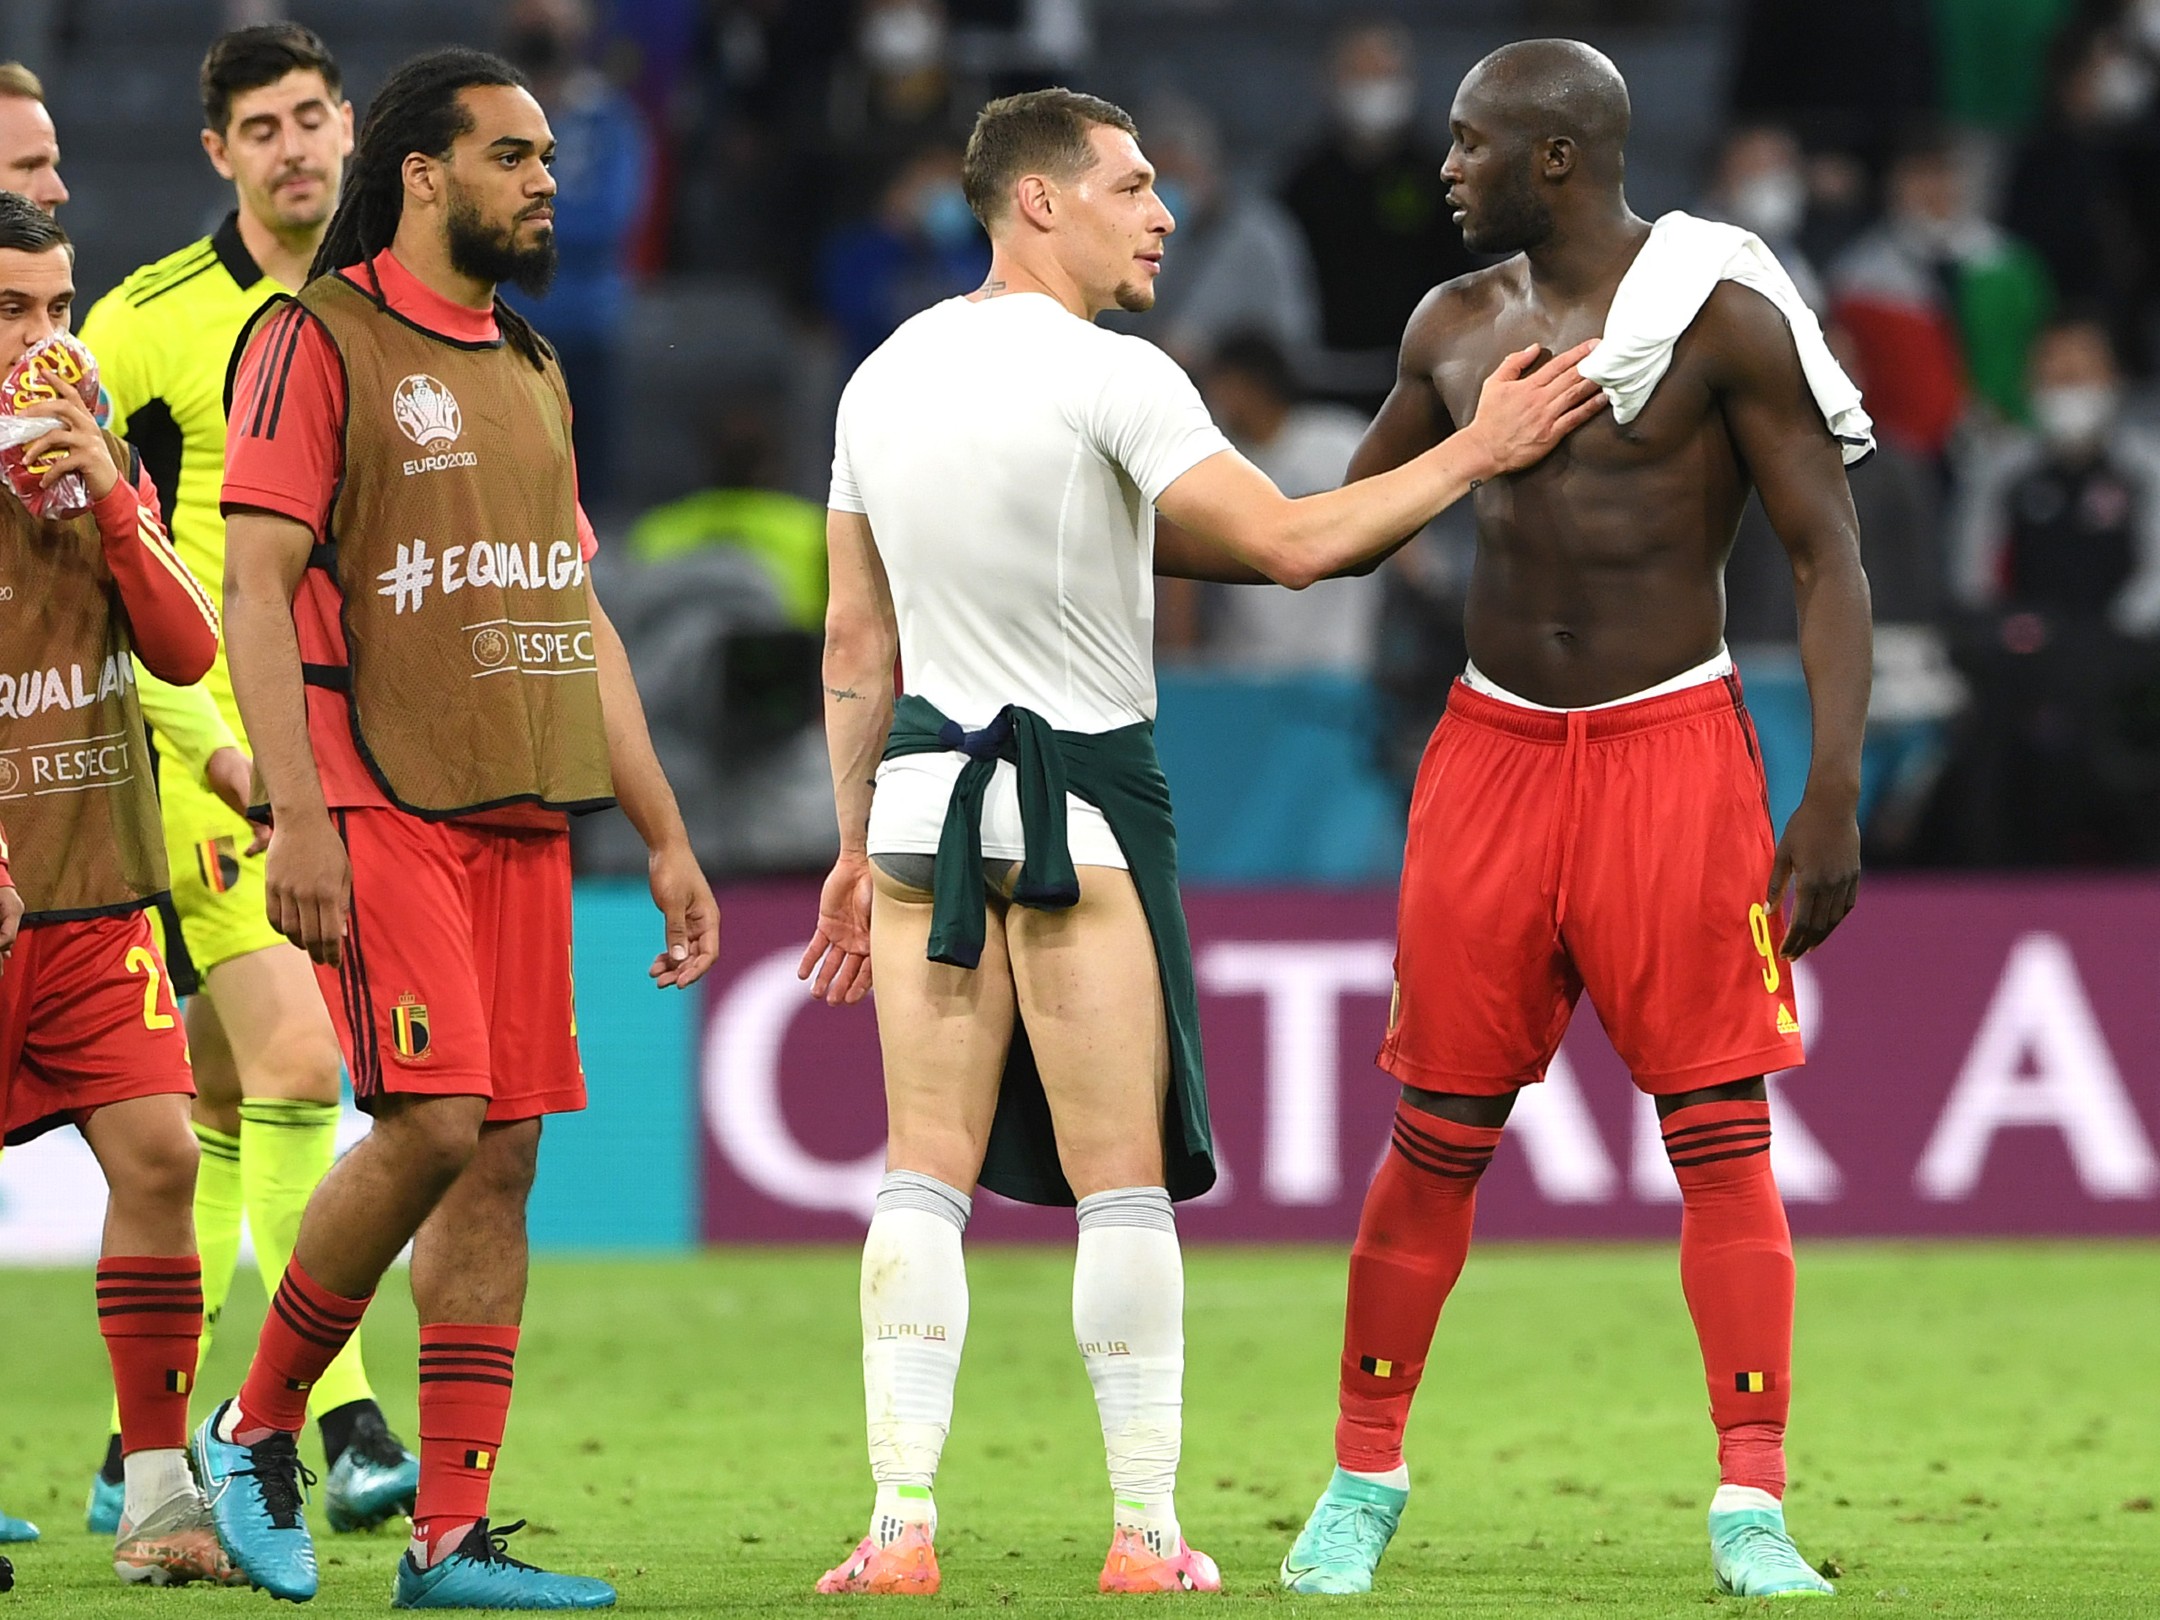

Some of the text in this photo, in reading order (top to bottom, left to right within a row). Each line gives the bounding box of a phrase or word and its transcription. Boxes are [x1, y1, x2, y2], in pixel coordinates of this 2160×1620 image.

[32, 742, 128, 784] RESECT
[1749, 903, 1779, 993] 9
[125, 946, 178, 1030] 2
[878, 1324, 946, 1338] ITALIA
